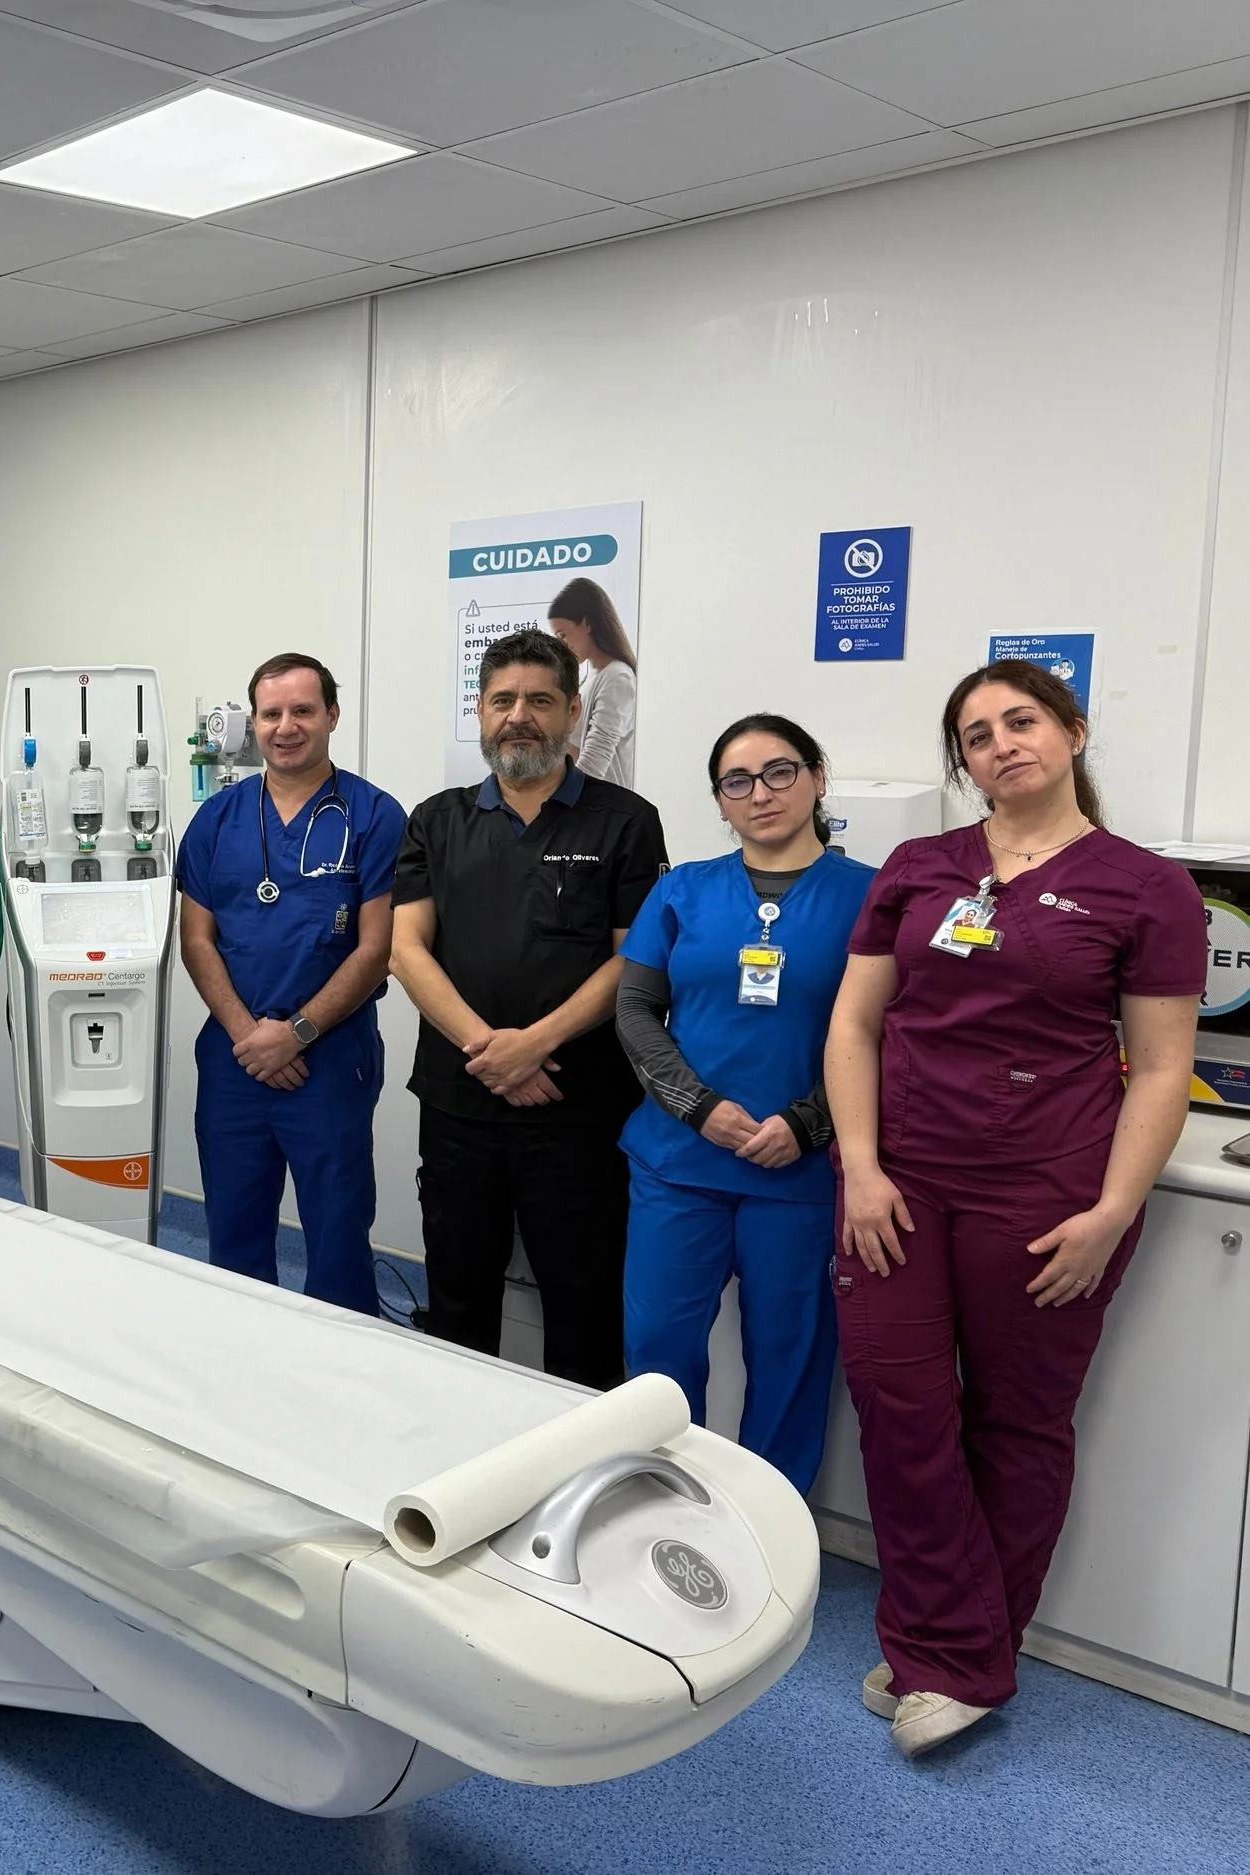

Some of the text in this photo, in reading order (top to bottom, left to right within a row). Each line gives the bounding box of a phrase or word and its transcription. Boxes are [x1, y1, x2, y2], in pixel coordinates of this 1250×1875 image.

[472, 543, 592, 572] CUIDADO
[833, 585, 890, 595] PROHIBIDO
[843, 595, 879, 604] TOMAR
[826, 602, 895, 613] FOTOGRAFÍAS
[464, 619, 538, 635] Si usted está
[464, 653, 471, 661] o
[464, 665, 479, 675] inf
[464, 681, 481, 689] TEC
[463, 693, 478, 702] ant
[463, 707, 478, 717] pru
[572, 854, 600, 862] Olivares
[108, 972, 145, 981] Centargo
